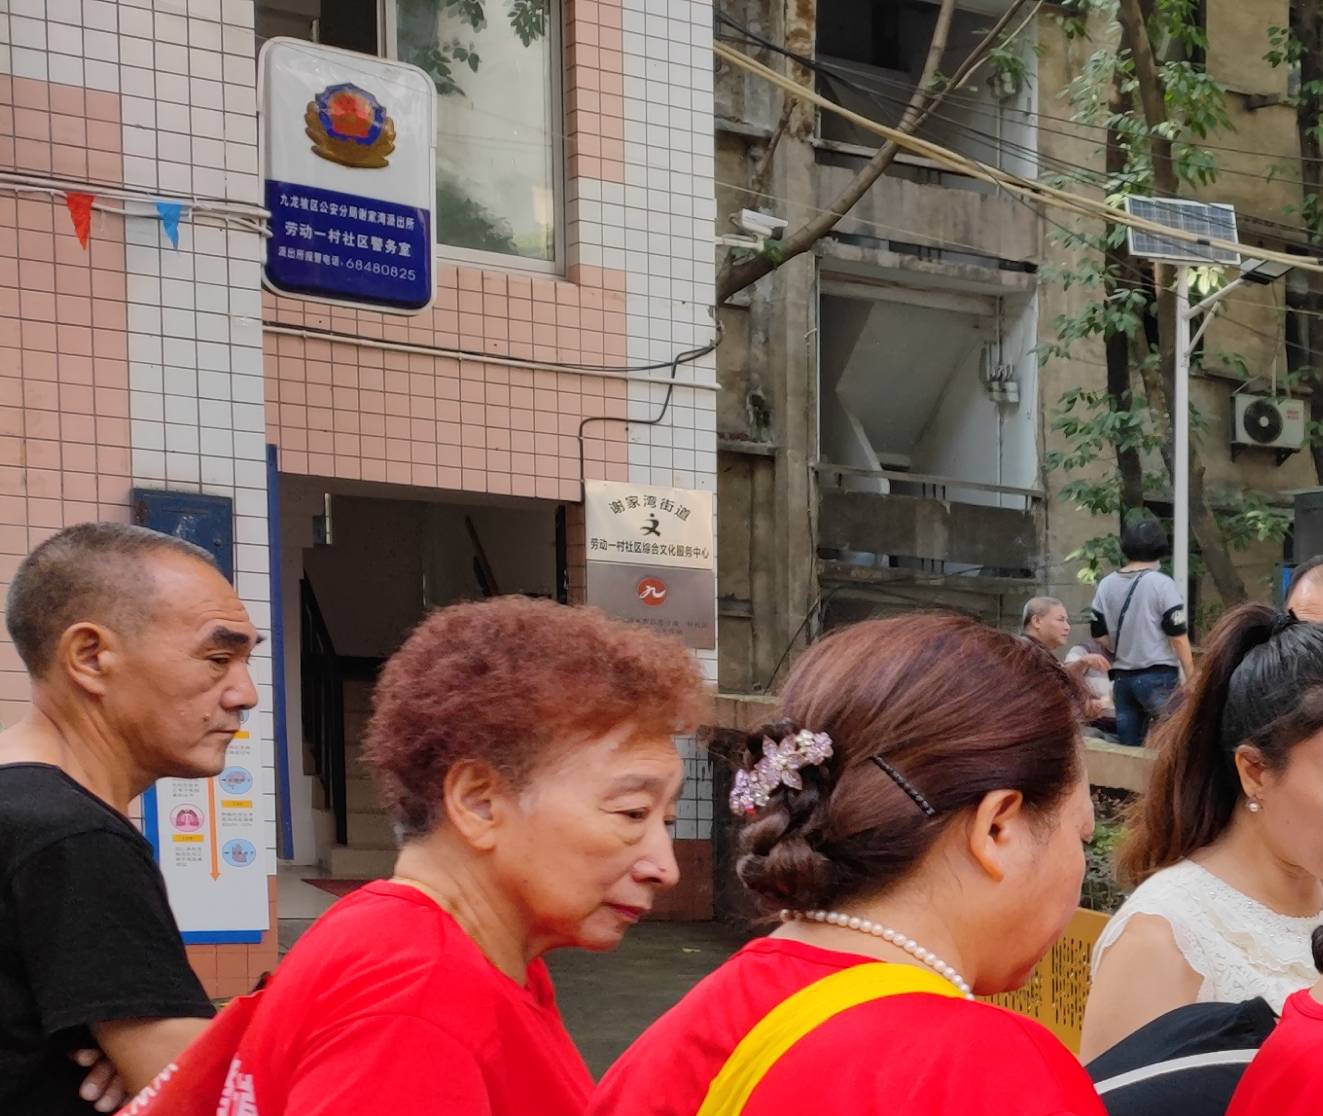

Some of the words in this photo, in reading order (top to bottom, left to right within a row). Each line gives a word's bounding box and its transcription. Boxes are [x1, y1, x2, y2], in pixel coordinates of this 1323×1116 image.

[280, 193, 415, 231] 九龙坡区公安分局谢家湾派出所
[284, 221, 412, 258] 劳动一村社区警务室
[608, 494, 691, 522] 谢家湾街道
[590, 537, 710, 560] 劳动一村社区综合文化服务中心
